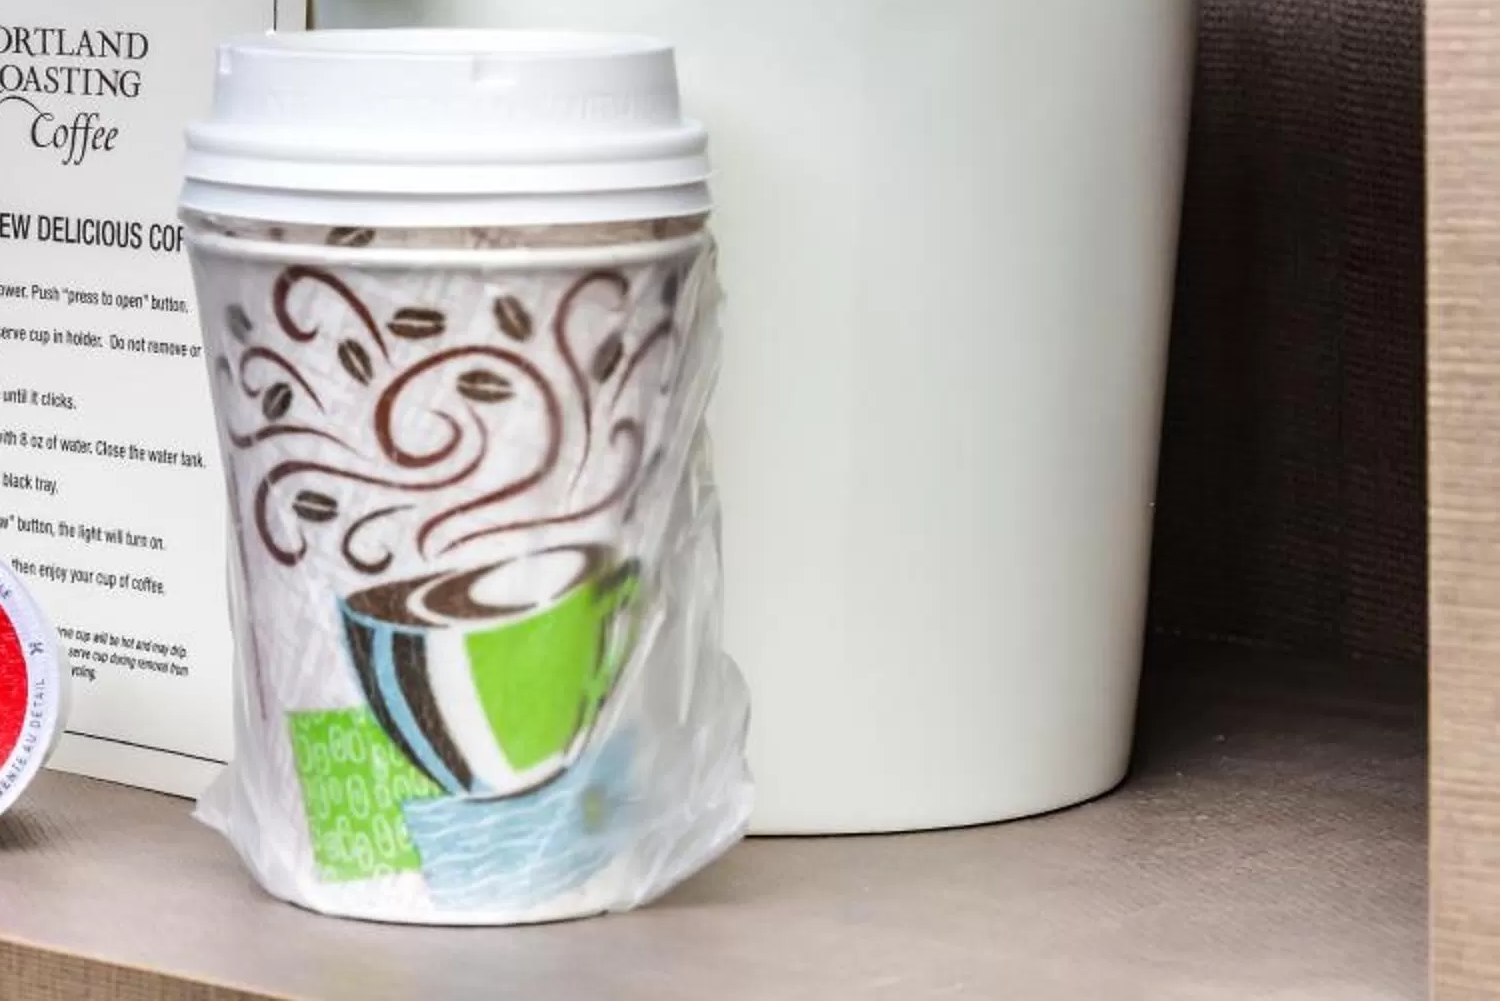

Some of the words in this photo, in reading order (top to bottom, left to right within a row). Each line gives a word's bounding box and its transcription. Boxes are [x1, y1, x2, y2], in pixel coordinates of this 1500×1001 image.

[8, 100, 120, 167] Coffee
[37, 216, 142, 249] DELICIOUS
[149, 223, 184, 252] COF
[31, 284, 59, 300] Push
[101, 291, 113, 306] to
[29, 329, 51, 345] cup
[53, 329, 63, 344] in
[65, 330, 103, 348] holder.
[109, 334, 125, 350] Do
[127, 338, 146, 352] not
[147, 340, 187, 357] remove
[189, 345, 202, 358] or
[2, 388, 27, 404] until
[31, 390, 39, 405] it
[41, 392, 77, 410] clicks.
[19, 432, 28, 447] 8
[30, 436, 43, 449] oz
[46, 435, 57, 450] of
[60, 438, 93, 455] water.
[95, 440, 126, 458] Close
[129, 444, 146, 461] the
[148, 448, 178, 464] water
[181, 450, 206, 469] tank.
[2, 472, 33, 489] black
[35, 476, 58, 495] tray.
[17, 516, 55, 537] button,
[58, 521, 76, 538] the
[78, 524, 102, 543] light
[104, 528, 123, 544] will
[125, 531, 147, 547] turn
[38, 563, 68, 583] enjoy
[69, 568, 94, 584] your
[95, 571, 117, 589] cup
[119, 573, 129, 589] of
